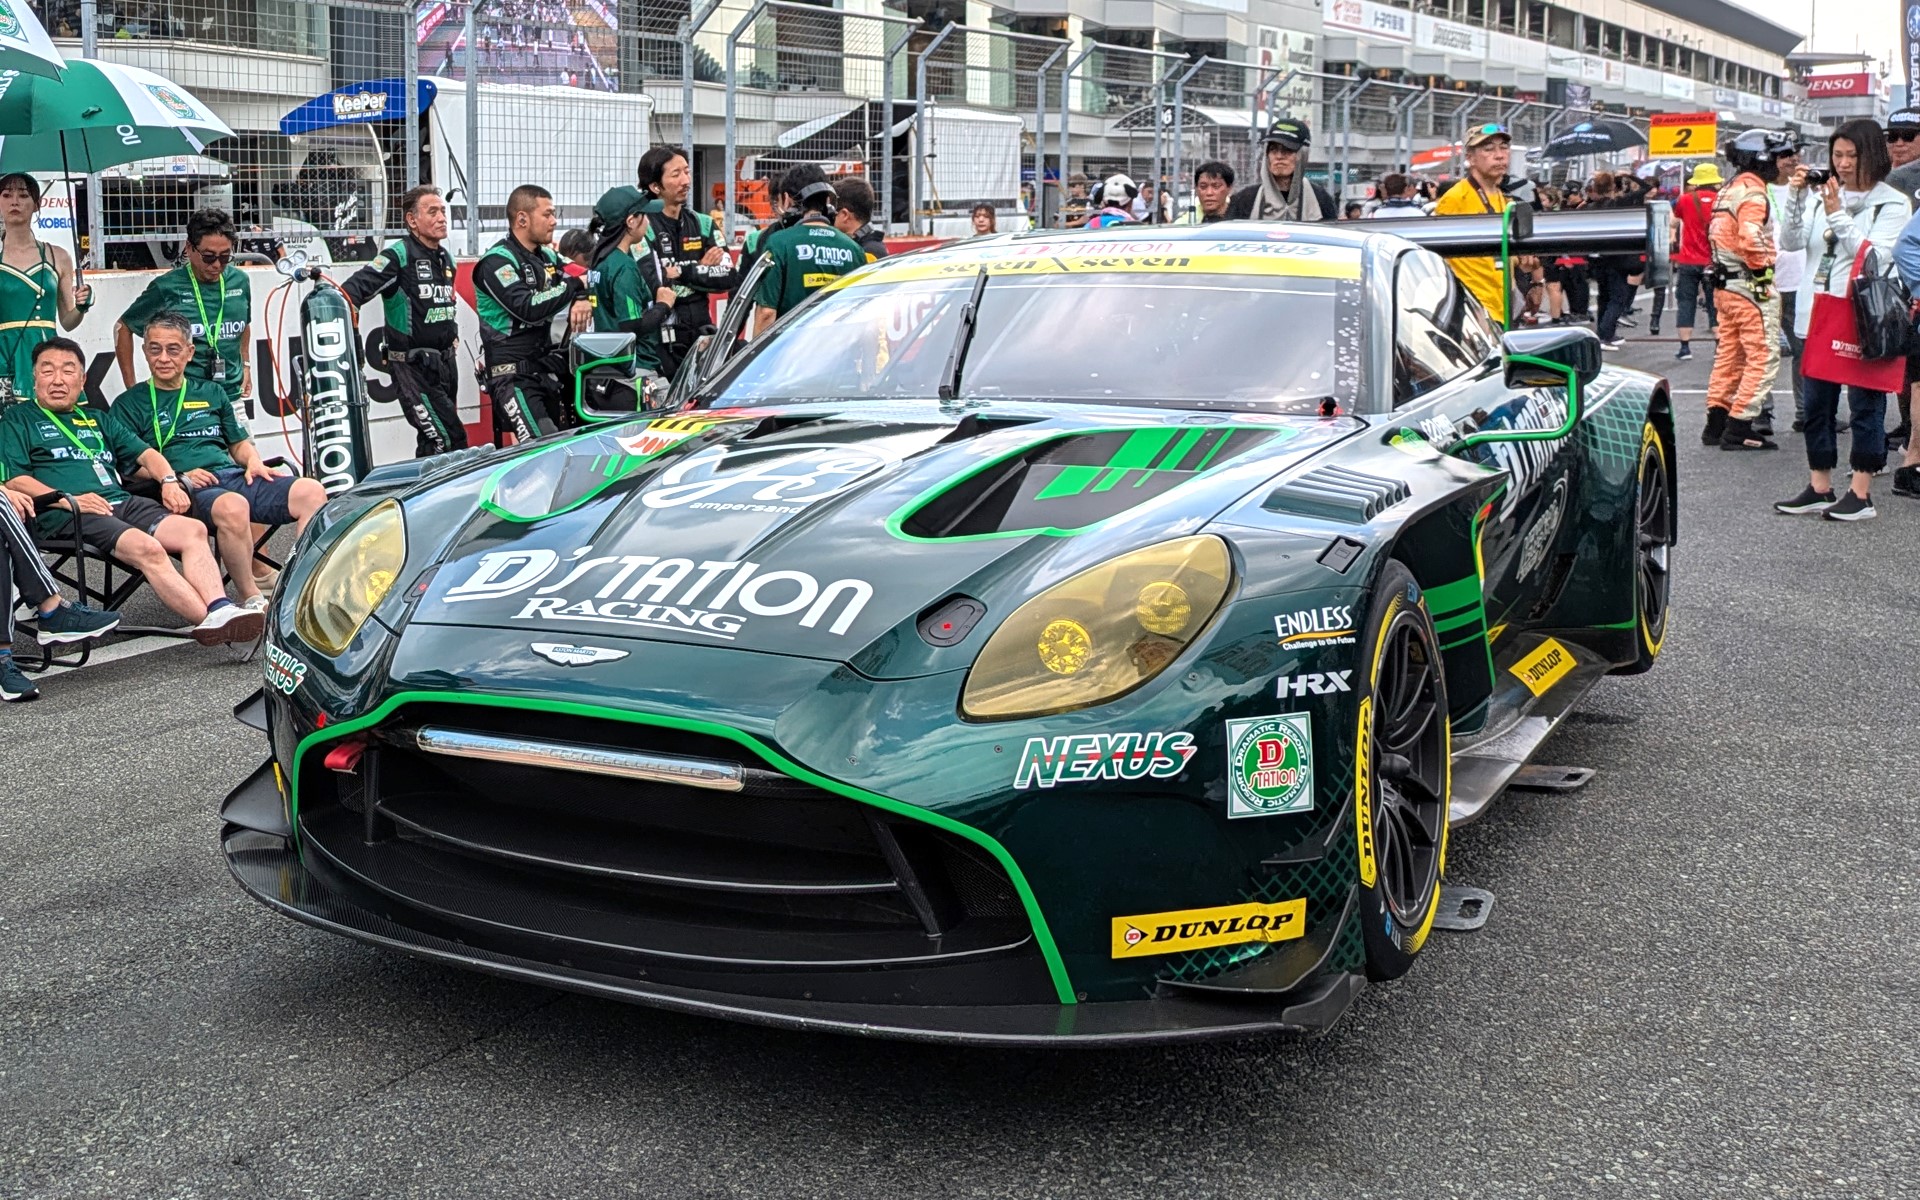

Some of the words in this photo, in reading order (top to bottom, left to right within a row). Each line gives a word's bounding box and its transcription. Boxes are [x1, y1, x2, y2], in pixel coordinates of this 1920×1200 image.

[1663, 116, 1714, 124] AUTOBACS
[1673, 128, 1693, 148] 2
[795, 244, 853, 263] D'STATION
[1017, 242, 1173, 256] D'STATION
[1079, 256, 1191, 268] seven
[1205, 243, 1321, 256] NEXUS
[689, 501, 805, 514] ampersand
[442, 545, 874, 636] D'STATION
[510, 597, 747, 638] RACING
[1274, 605, 1353, 637] ENDLESS
[574, 648, 597, 656] MARTIN
[1282, 639, 1318, 651] Challenge
[1326, 637, 1337, 645] the
[1337, 635, 1356, 644] Future
[1528, 648, 1562, 681] DUNLOP
[1276, 669, 1352, 699] HRX
[1235, 723, 1276, 767] DRAMATIC
[1278, 723, 1307, 761] RESORT
[1013, 731, 1197, 789] NEXUS
[1235, 770, 1264, 807] RESORT
[1248, 767, 1297, 790] STATION
[1267, 764, 1308, 808] DRAMATIC
[1362, 707, 1374, 860] DUNLOP
[1150, 912, 1295, 943] DUNLOP
